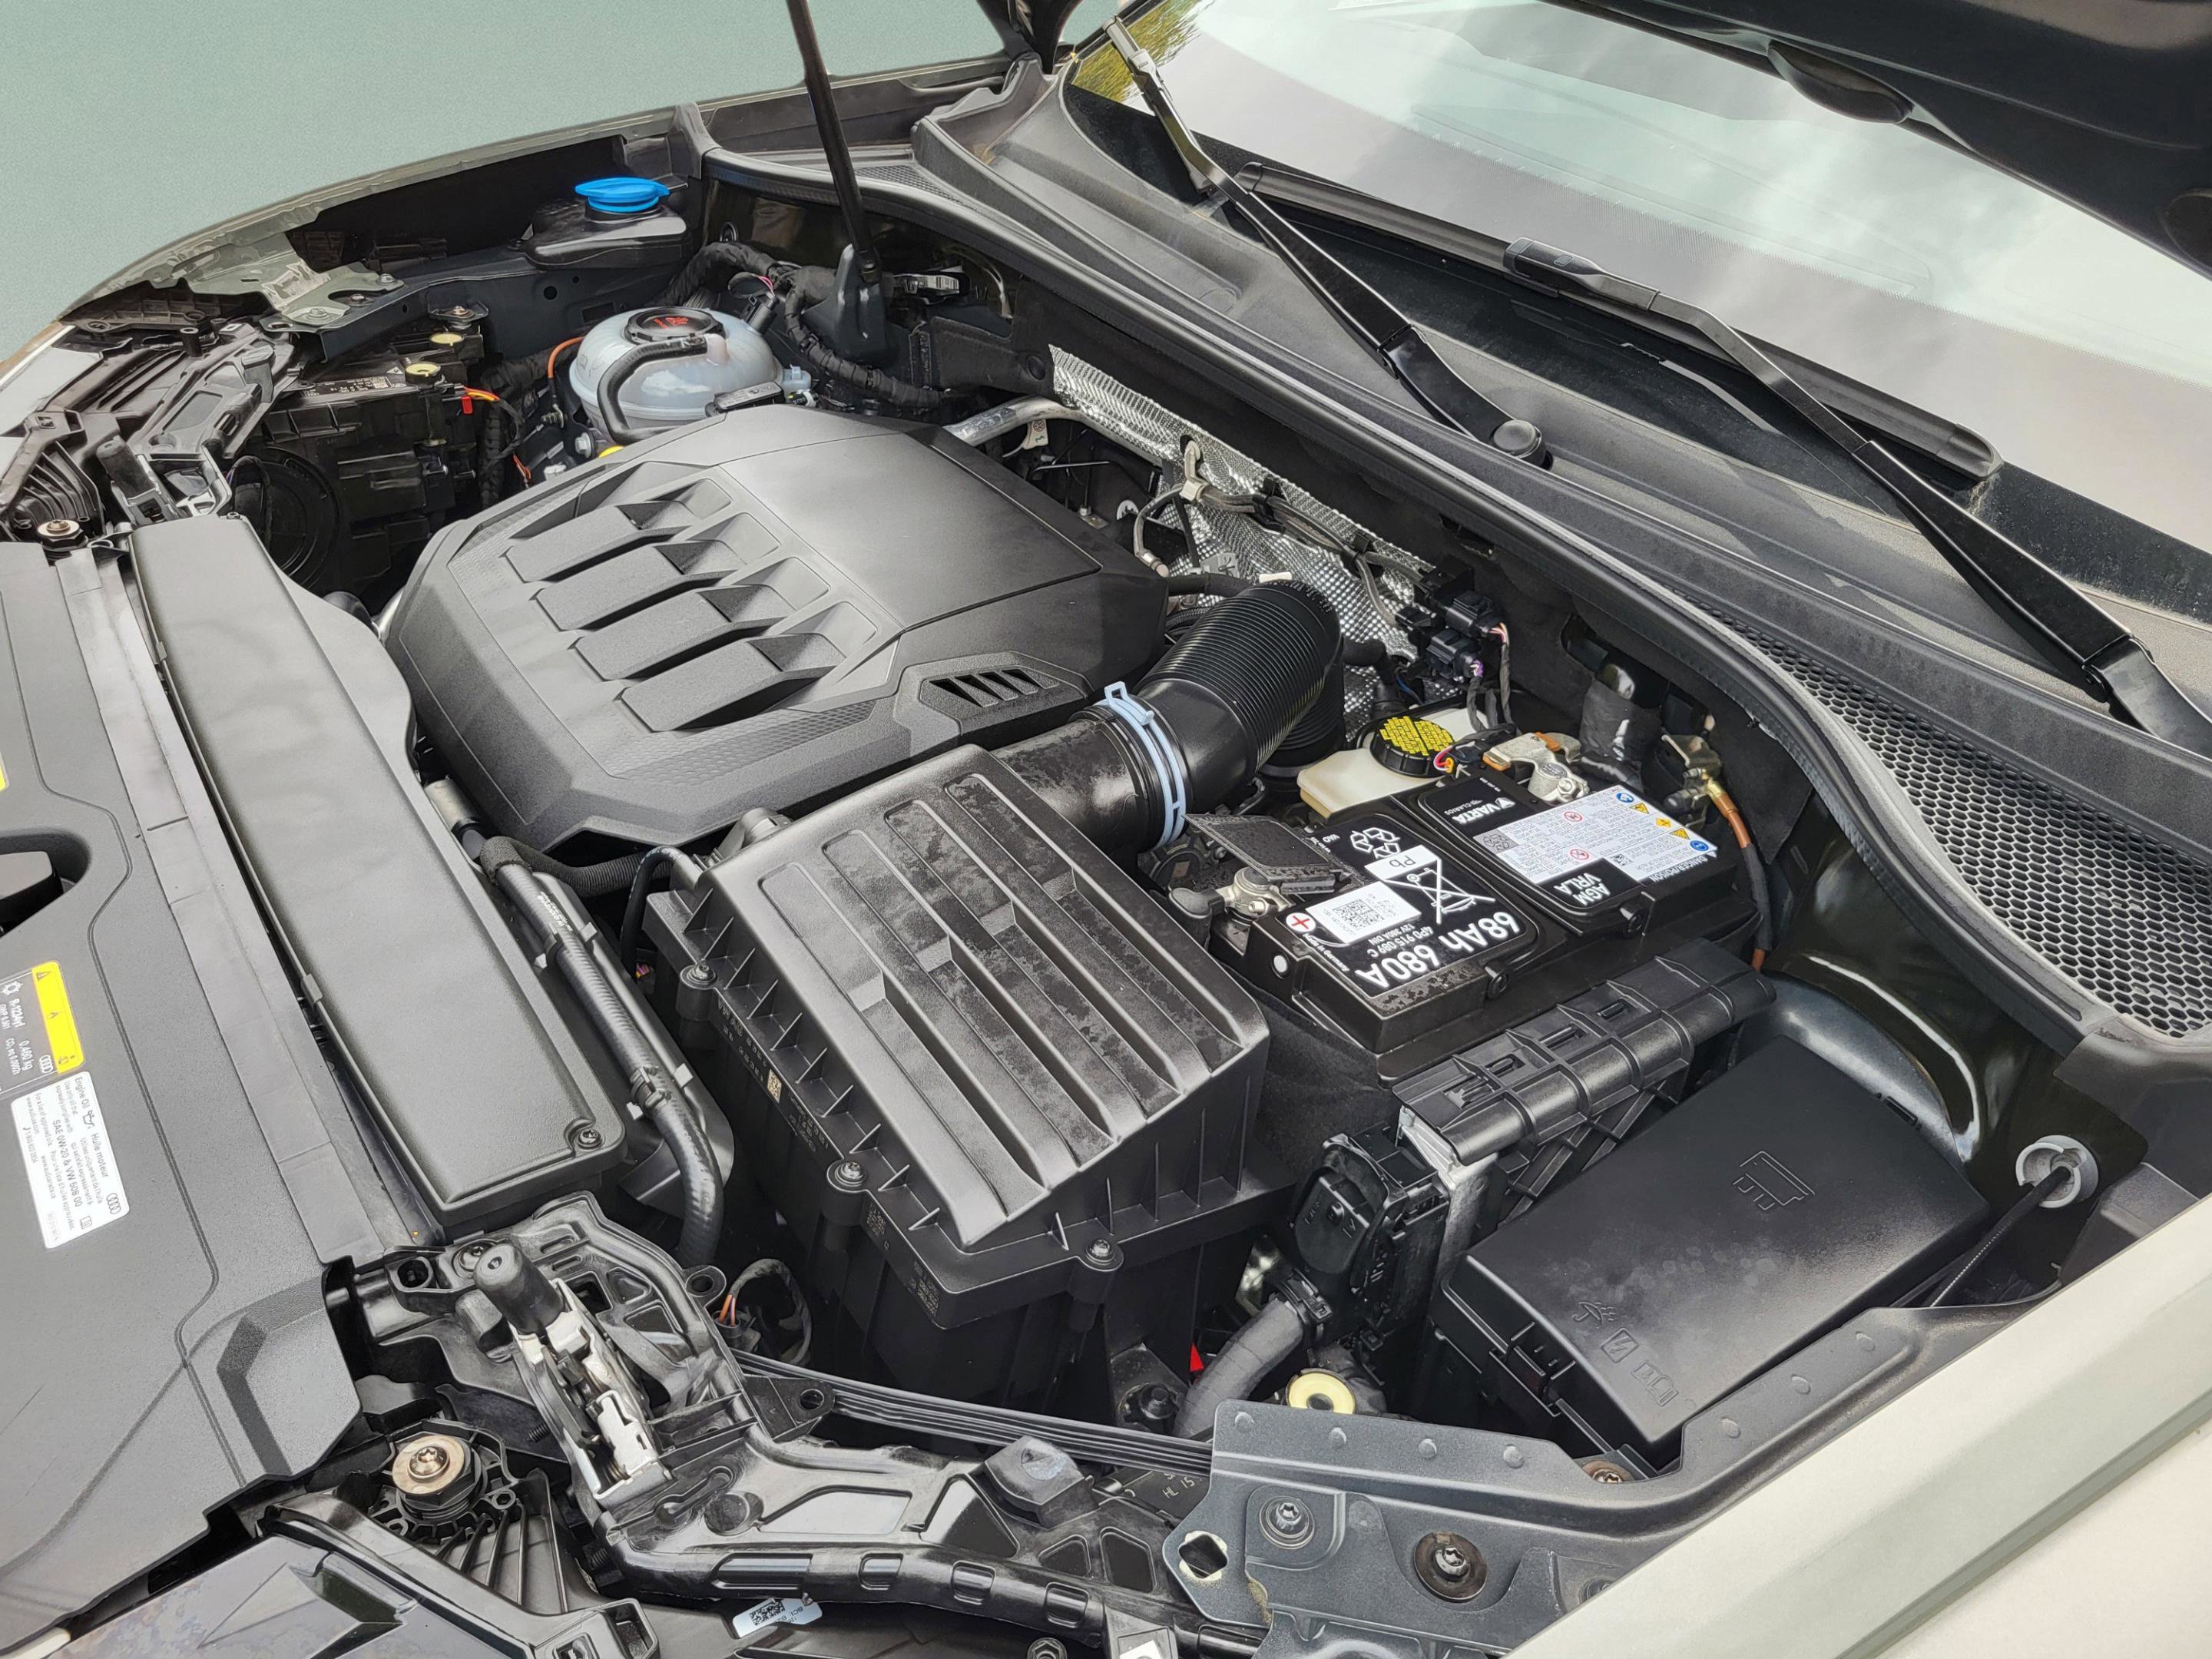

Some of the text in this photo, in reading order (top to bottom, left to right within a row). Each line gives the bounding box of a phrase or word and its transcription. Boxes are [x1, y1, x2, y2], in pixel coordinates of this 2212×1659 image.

[1452, 802, 1501, 824] VARTA
[1389, 856, 1416, 870] Pb
[1649, 856, 1708, 882] DANGER/POISON
[1554, 872, 1601, 894] VRLA
[1572, 882, 1611, 906] AGM
[1368, 934, 1384, 945] DIN
[1395, 934, 1415, 946] 915
[1438, 912, 1520, 953] 68Ah
[1367, 948, 1379, 958] C
[1377, 940, 1396, 954] 089
[1354, 944, 1440, 988] 680A
[22, 1059, 34, 1071] kg
[75, 1077, 90, 1108] Engine Oil
[53, 1120, 63, 1134] SAE
[57, 1135, 69, 1158] 0W-20
[91, 1133, 108, 1177] Huile moteur
[66, 1166, 75, 1180] VW
